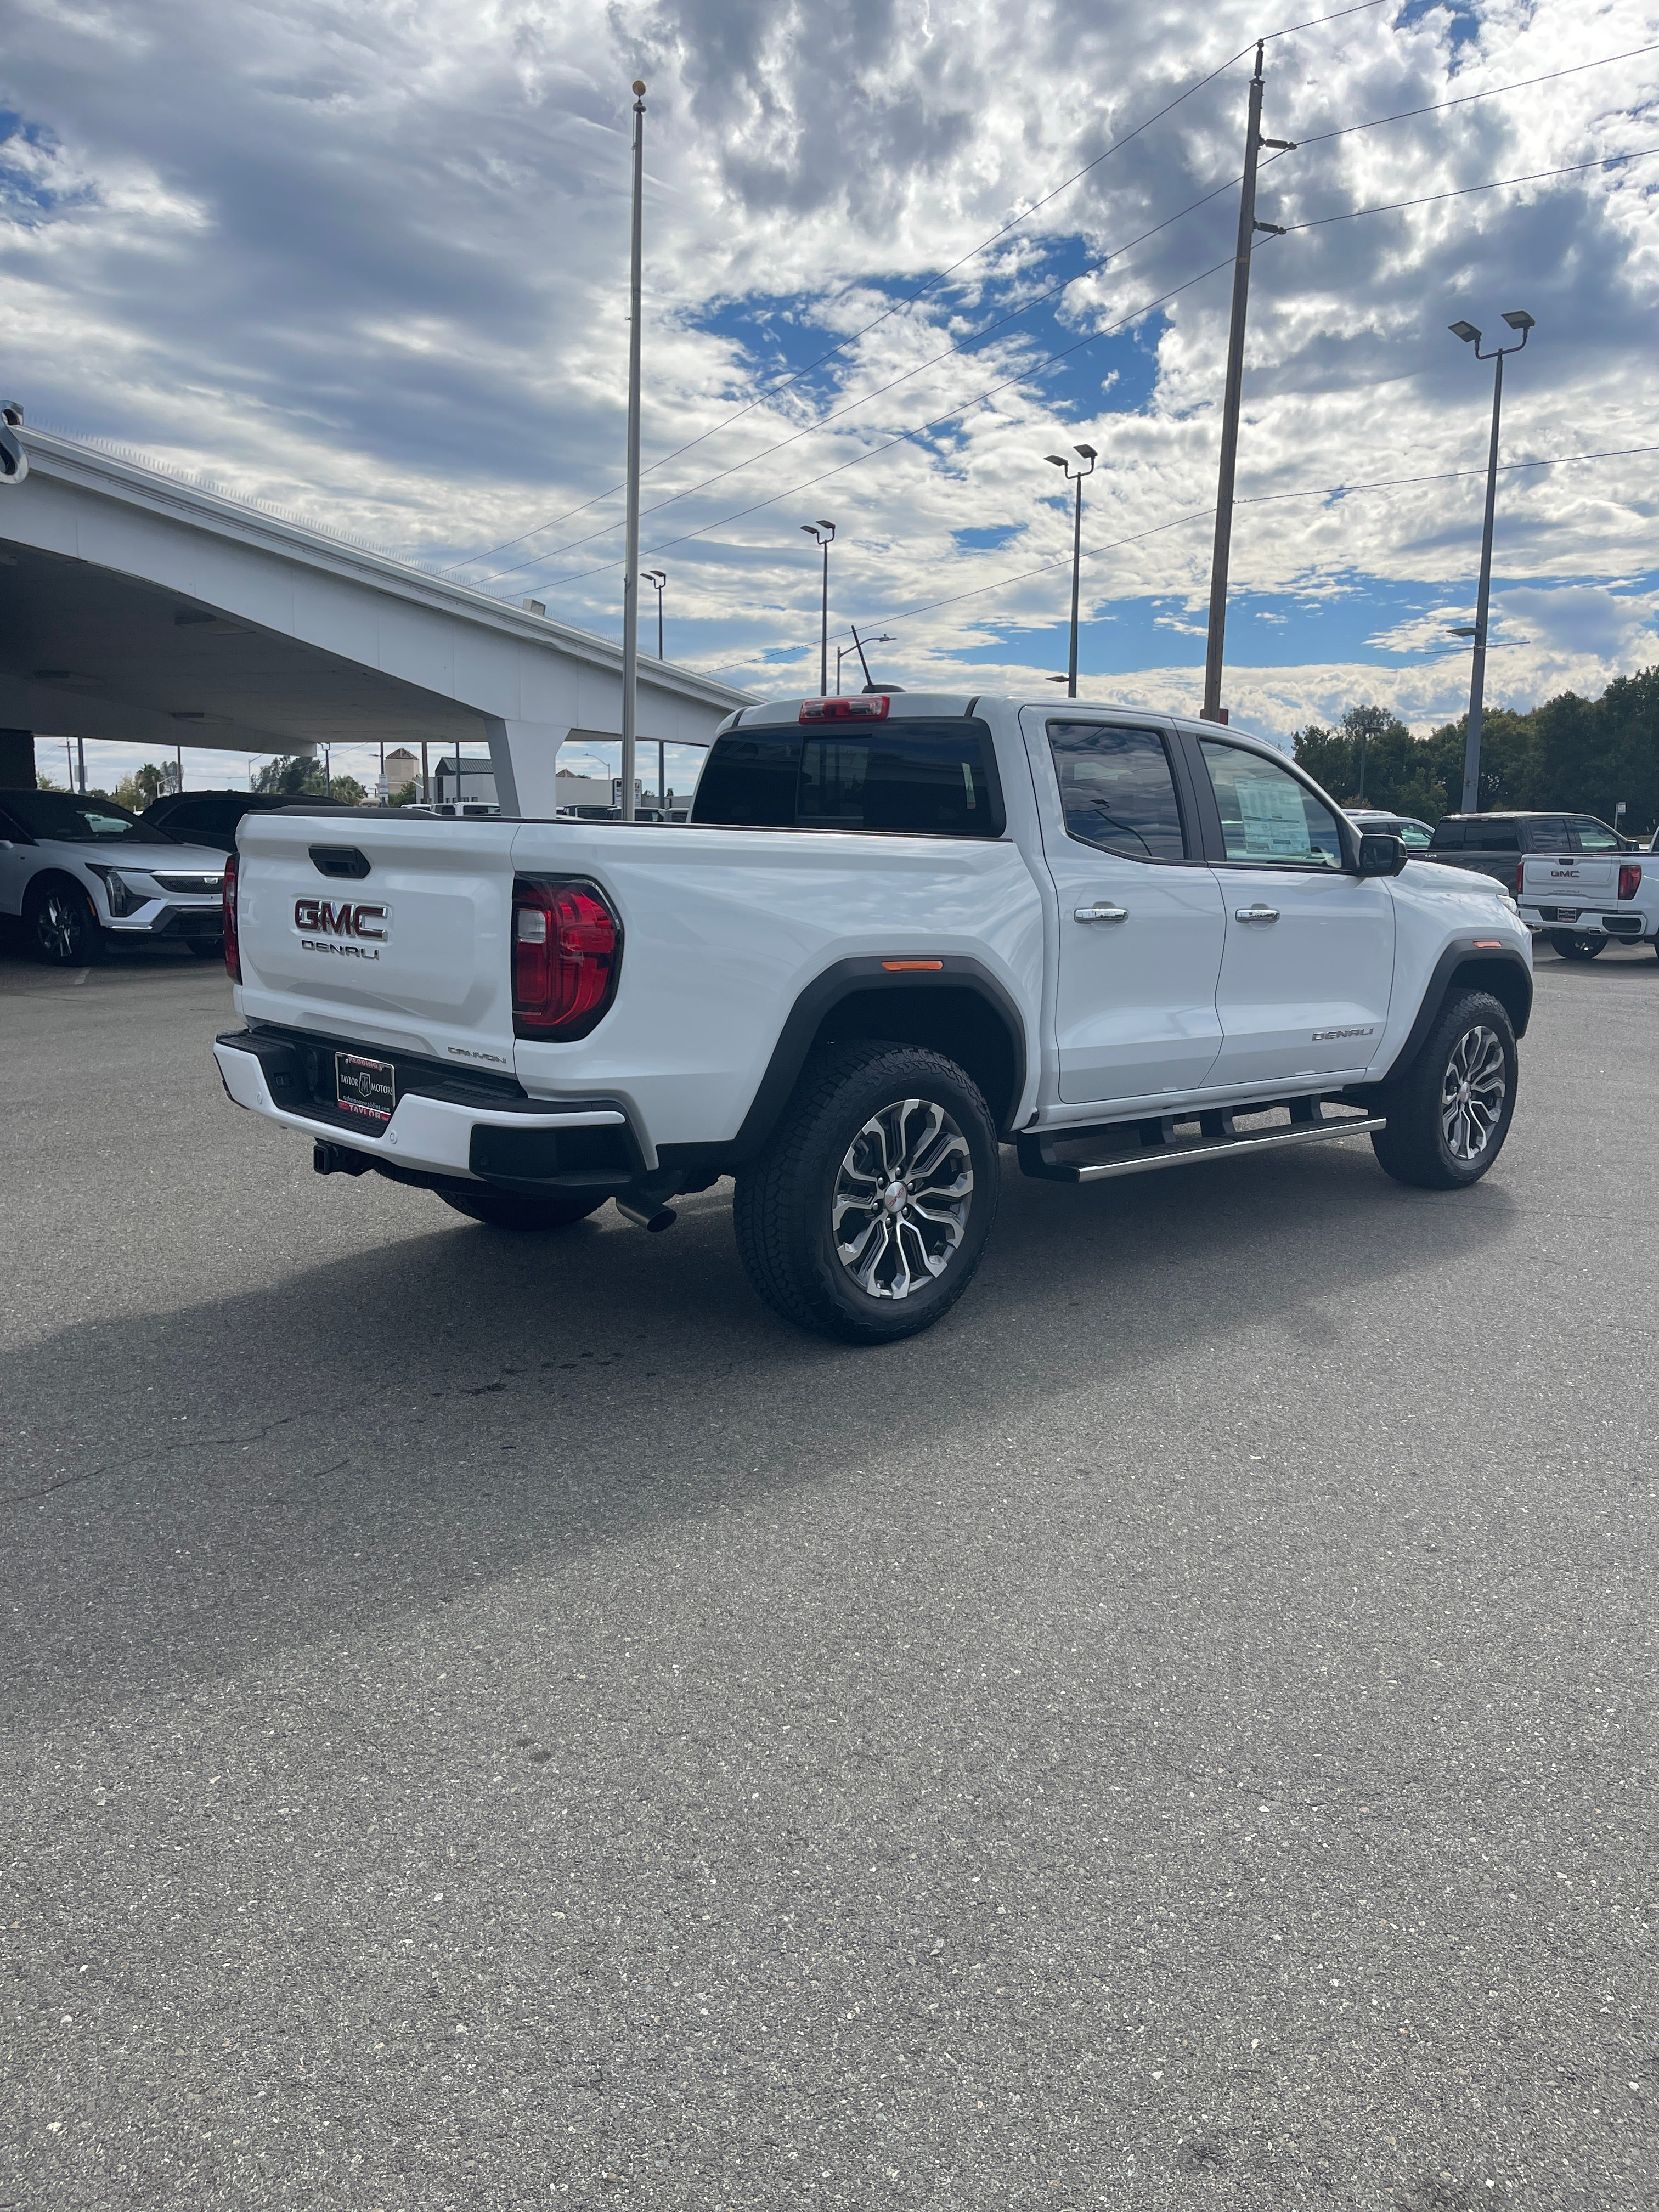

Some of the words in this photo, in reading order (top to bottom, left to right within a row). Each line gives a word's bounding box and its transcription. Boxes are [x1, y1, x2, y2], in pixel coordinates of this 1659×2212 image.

[295, 898, 388, 941] GMC
[302, 939, 380, 960] DENALI
[1312, 1028, 1374, 1041] DENALI
[348, 1057, 379, 1068] REDDING
[448, 1046, 506, 1064] CANYON
[340, 1074, 359, 1087] TAYLOR
[371, 1082, 393, 1096] MOTORS
[888, 1187, 905, 1208] GMC
